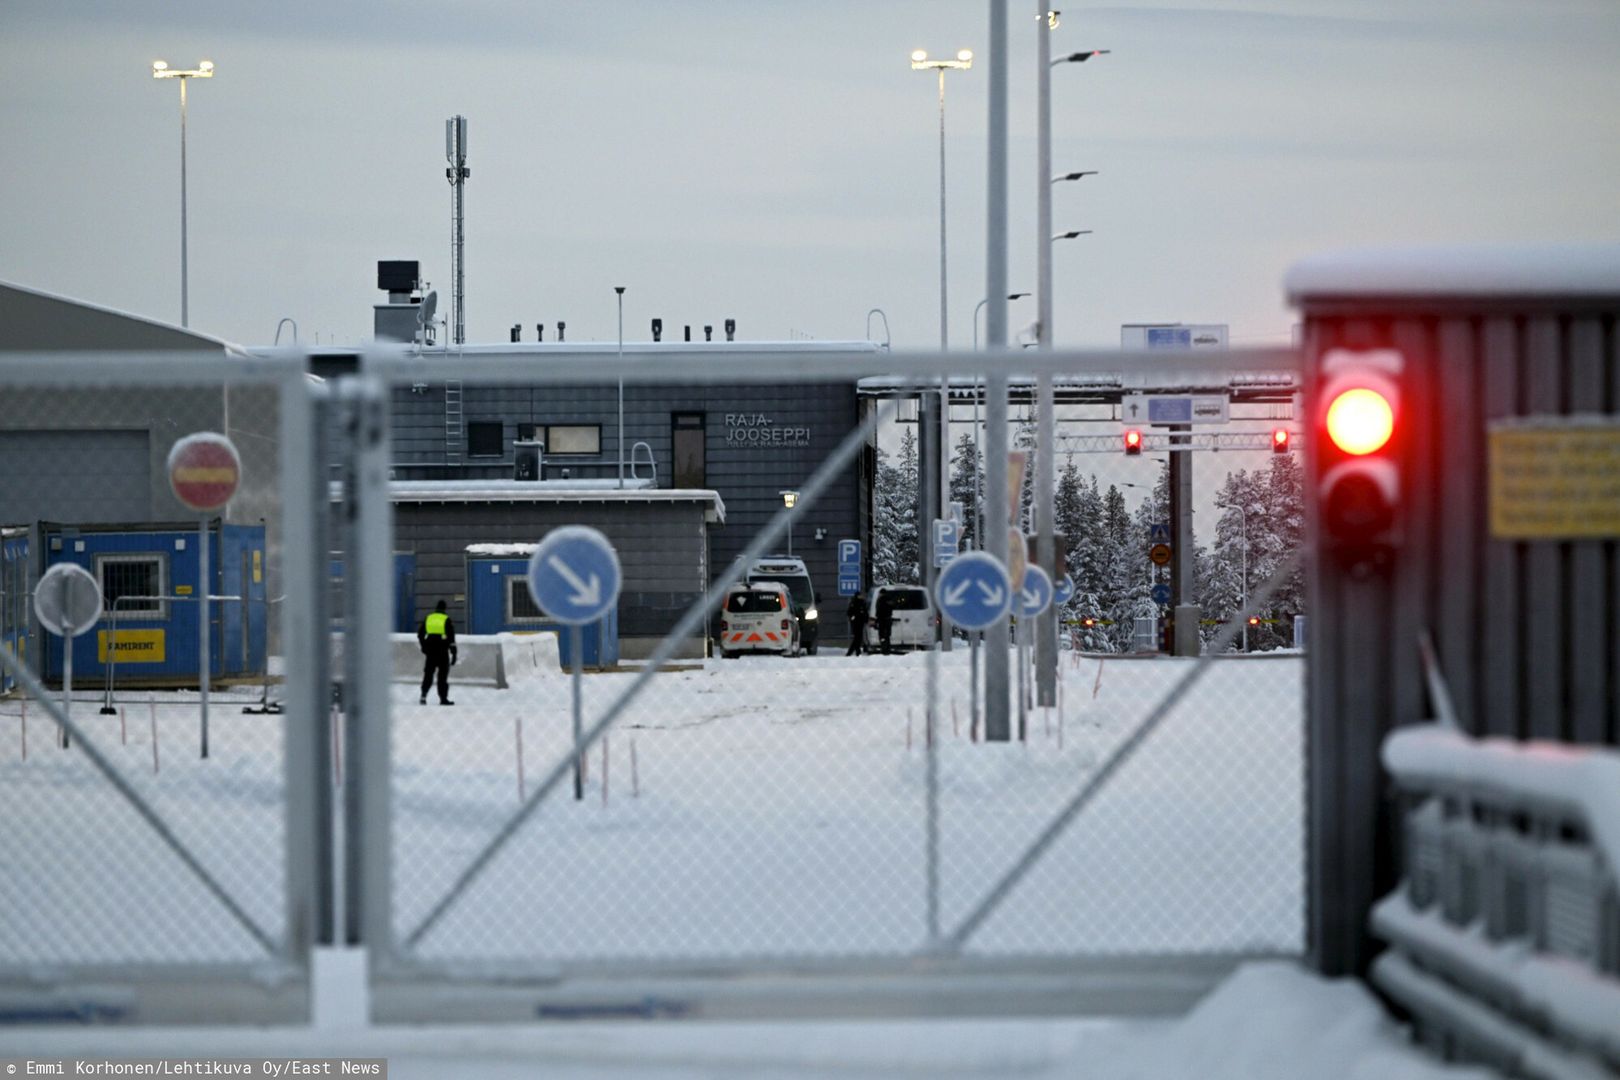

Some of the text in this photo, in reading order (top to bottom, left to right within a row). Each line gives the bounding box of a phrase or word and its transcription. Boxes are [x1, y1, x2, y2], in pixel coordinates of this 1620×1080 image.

[725, 414, 773, 426] RAJA-
[726, 428, 810, 441] JOOSEPPI
[842, 544, 856, 562] P
